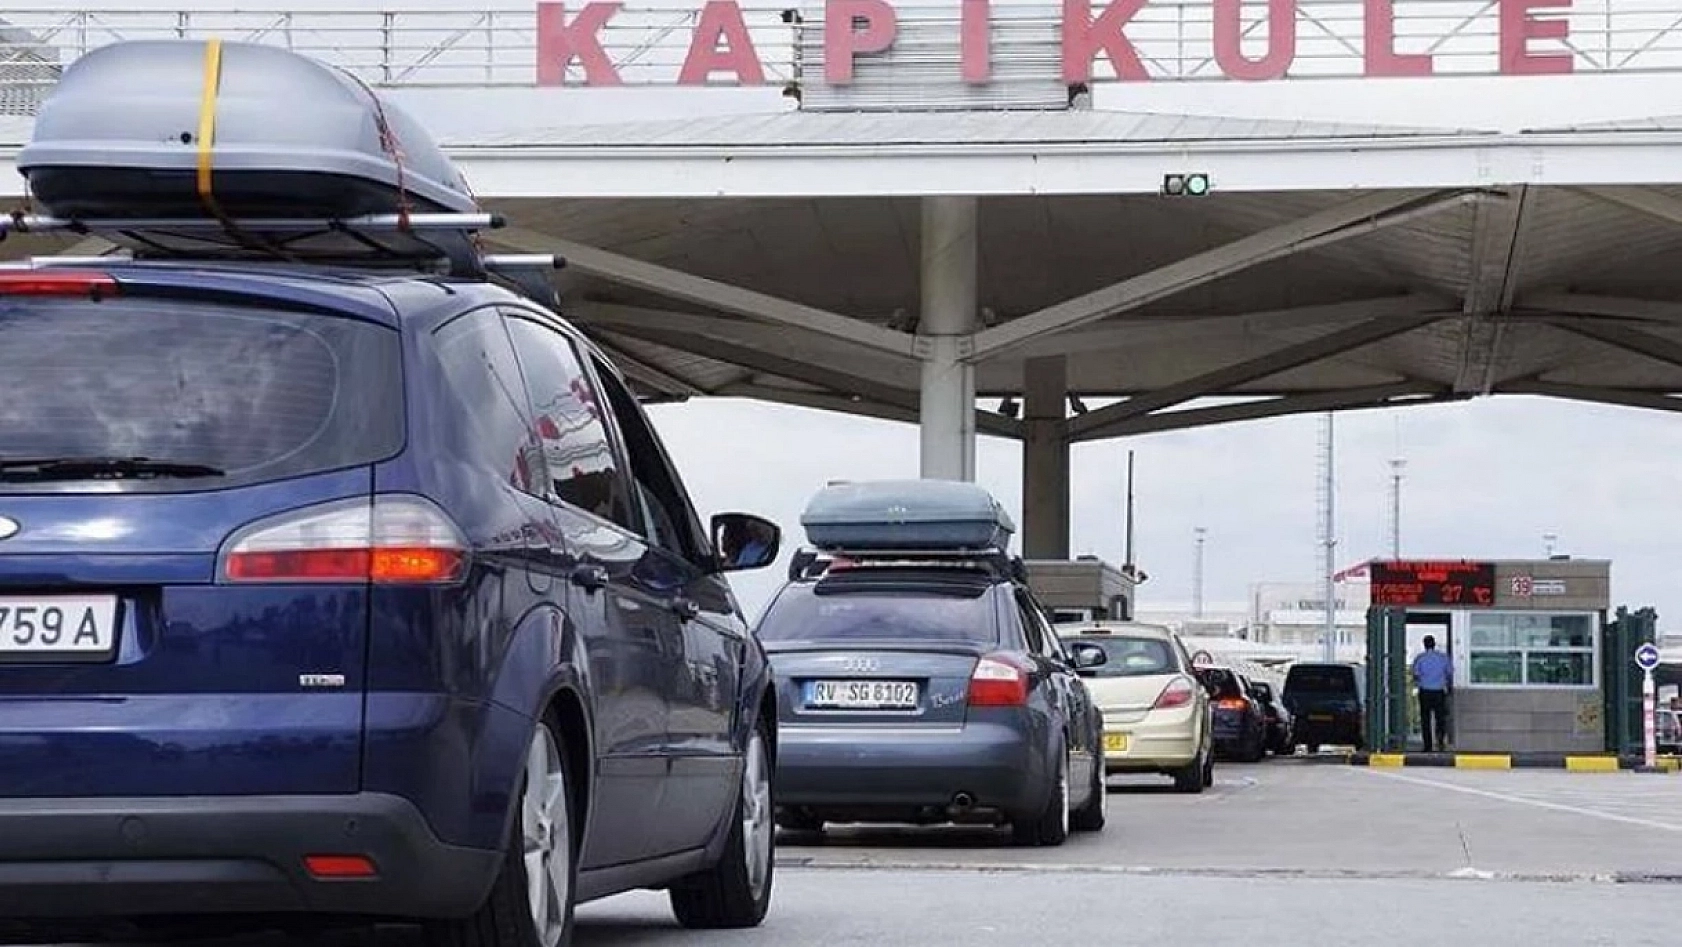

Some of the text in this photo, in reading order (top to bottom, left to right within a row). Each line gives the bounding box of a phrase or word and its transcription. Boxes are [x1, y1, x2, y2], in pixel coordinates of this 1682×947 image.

[536, 0, 1574, 87] KAPIKULE
[74, 606, 99, 645] A
[815, 682, 835, 701] RV
[848, 682, 870, 701] SG
